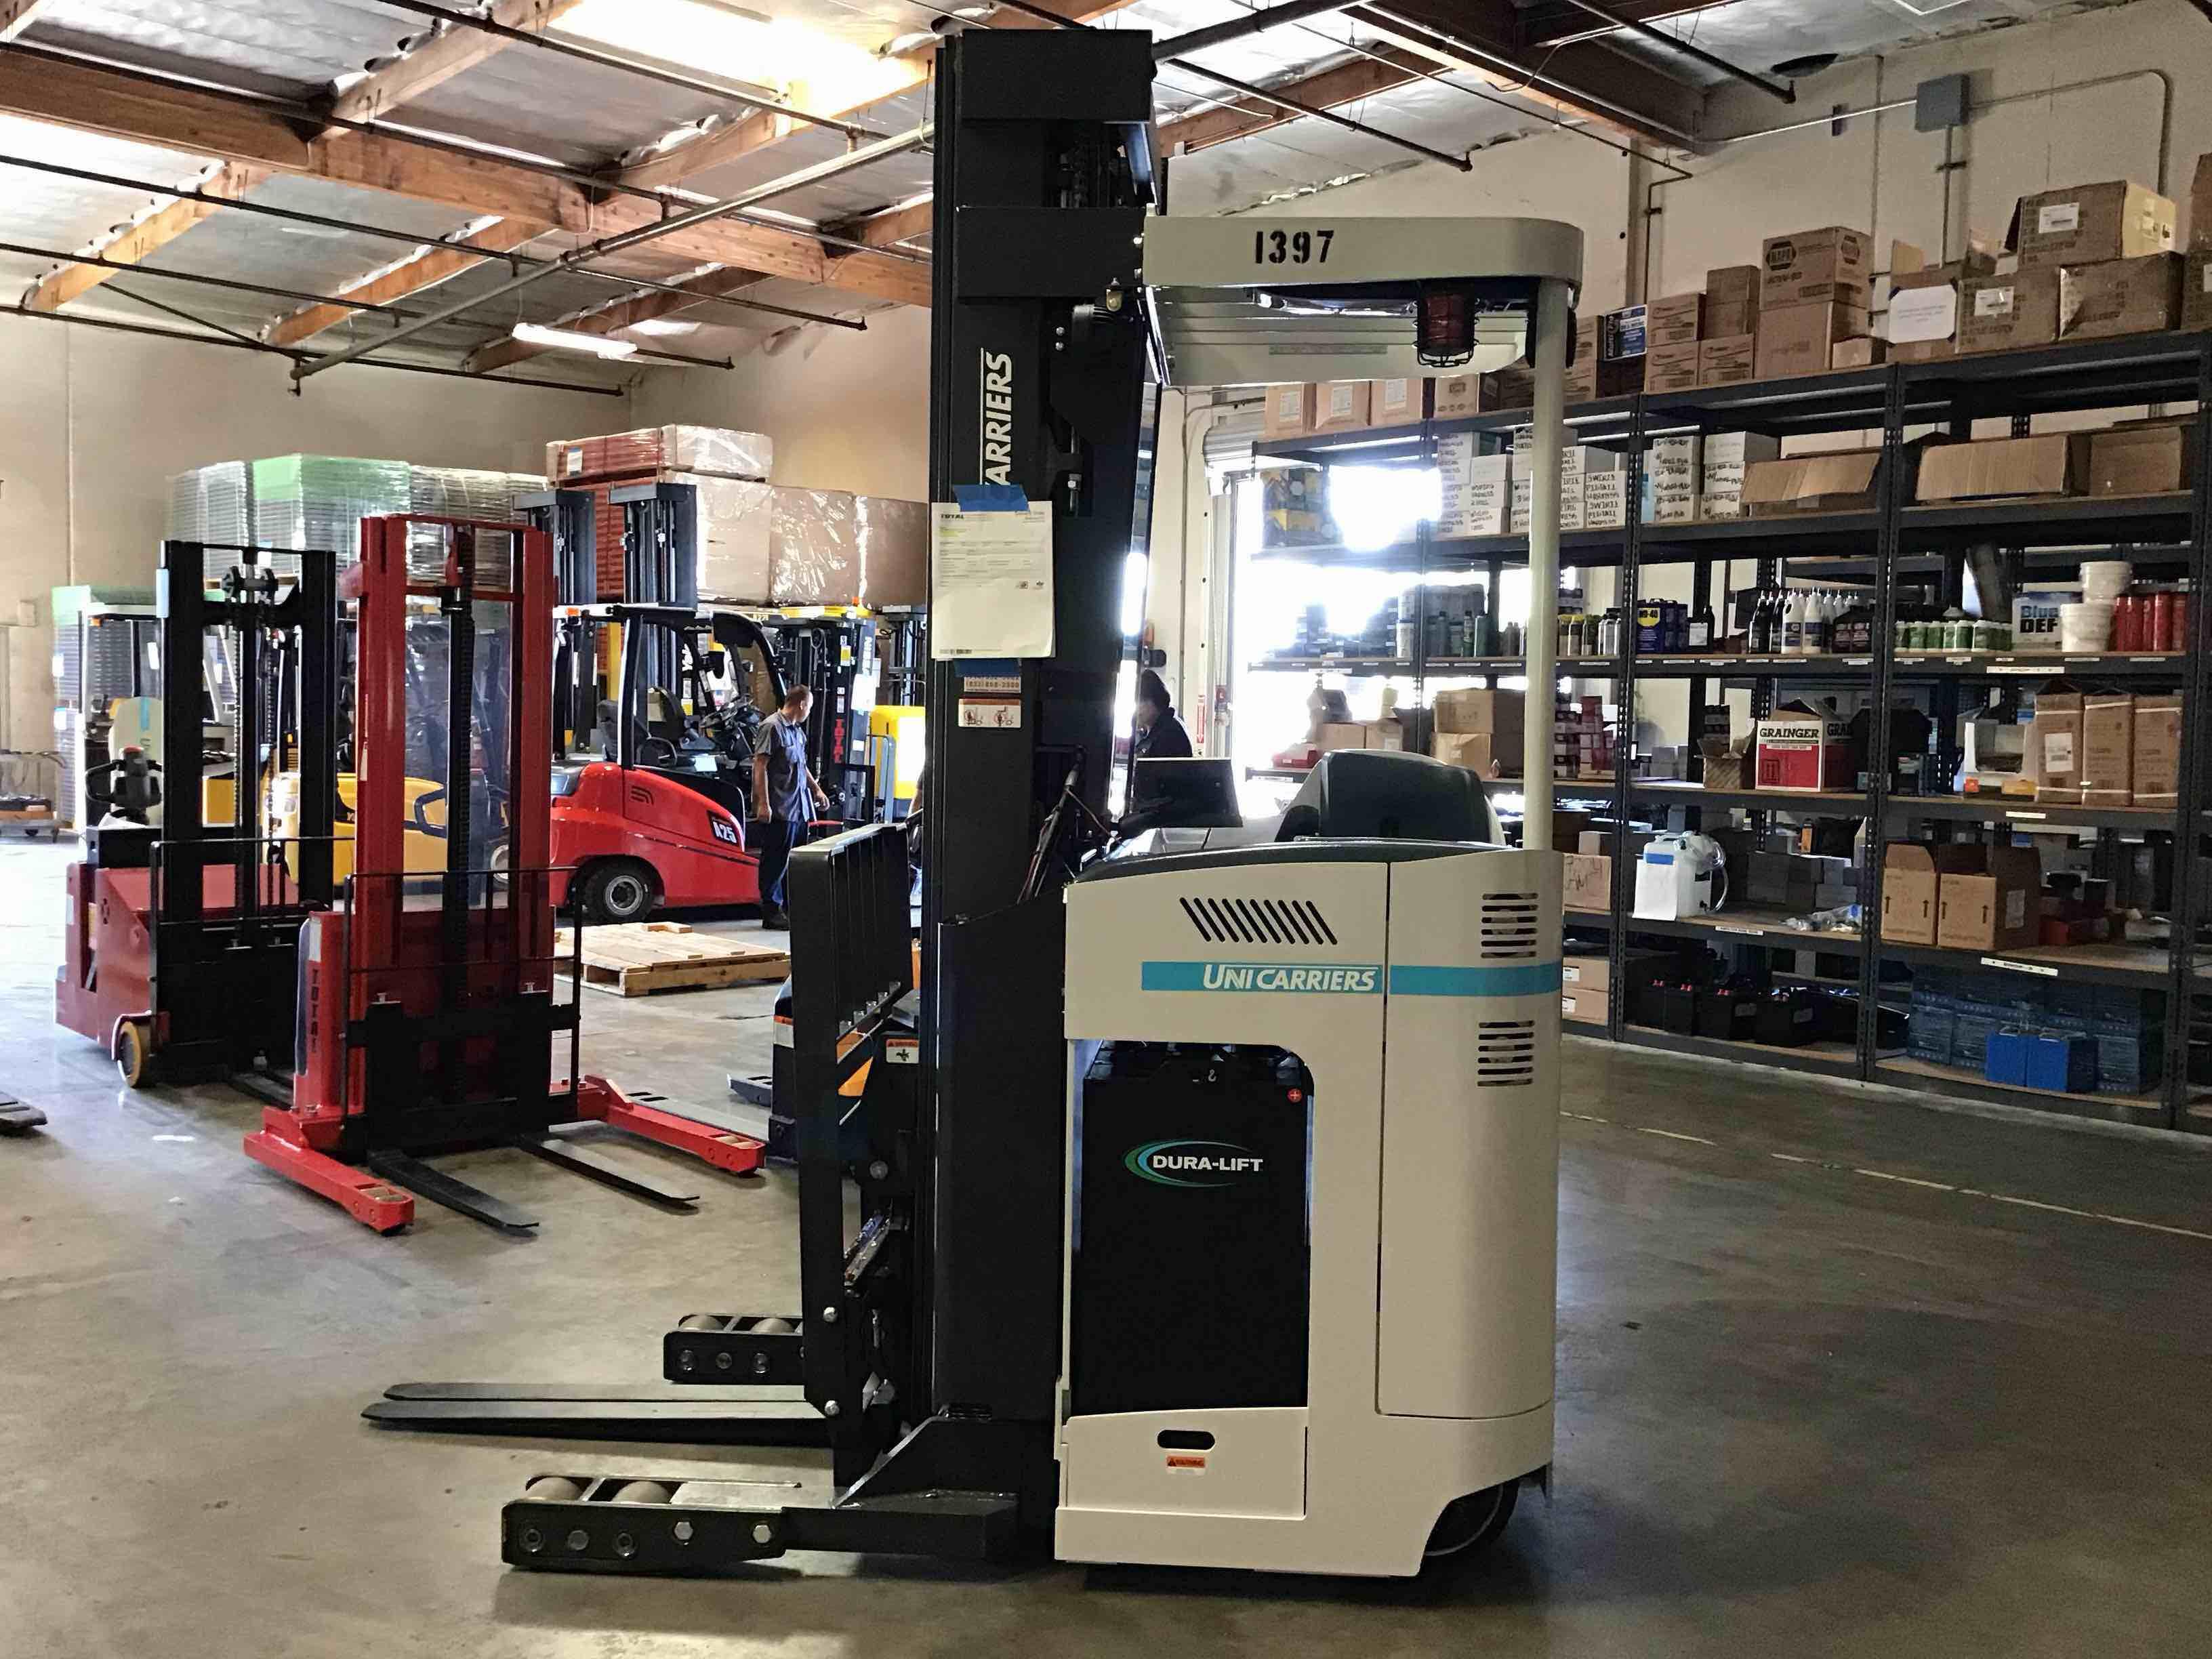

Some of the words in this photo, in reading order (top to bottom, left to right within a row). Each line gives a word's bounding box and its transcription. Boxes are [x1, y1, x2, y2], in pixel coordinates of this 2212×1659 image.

[1255, 230, 1334, 264] 1397
[2021, 605, 2059, 618] Blue
[2020, 618, 2058, 633] DEF
[834, 718, 846, 764] TOTAL
[1760, 728, 1819, 738] GRAINGER
[712, 821, 737, 844] A25
[1153, 1155, 1264, 1172] DURA-LIFT
